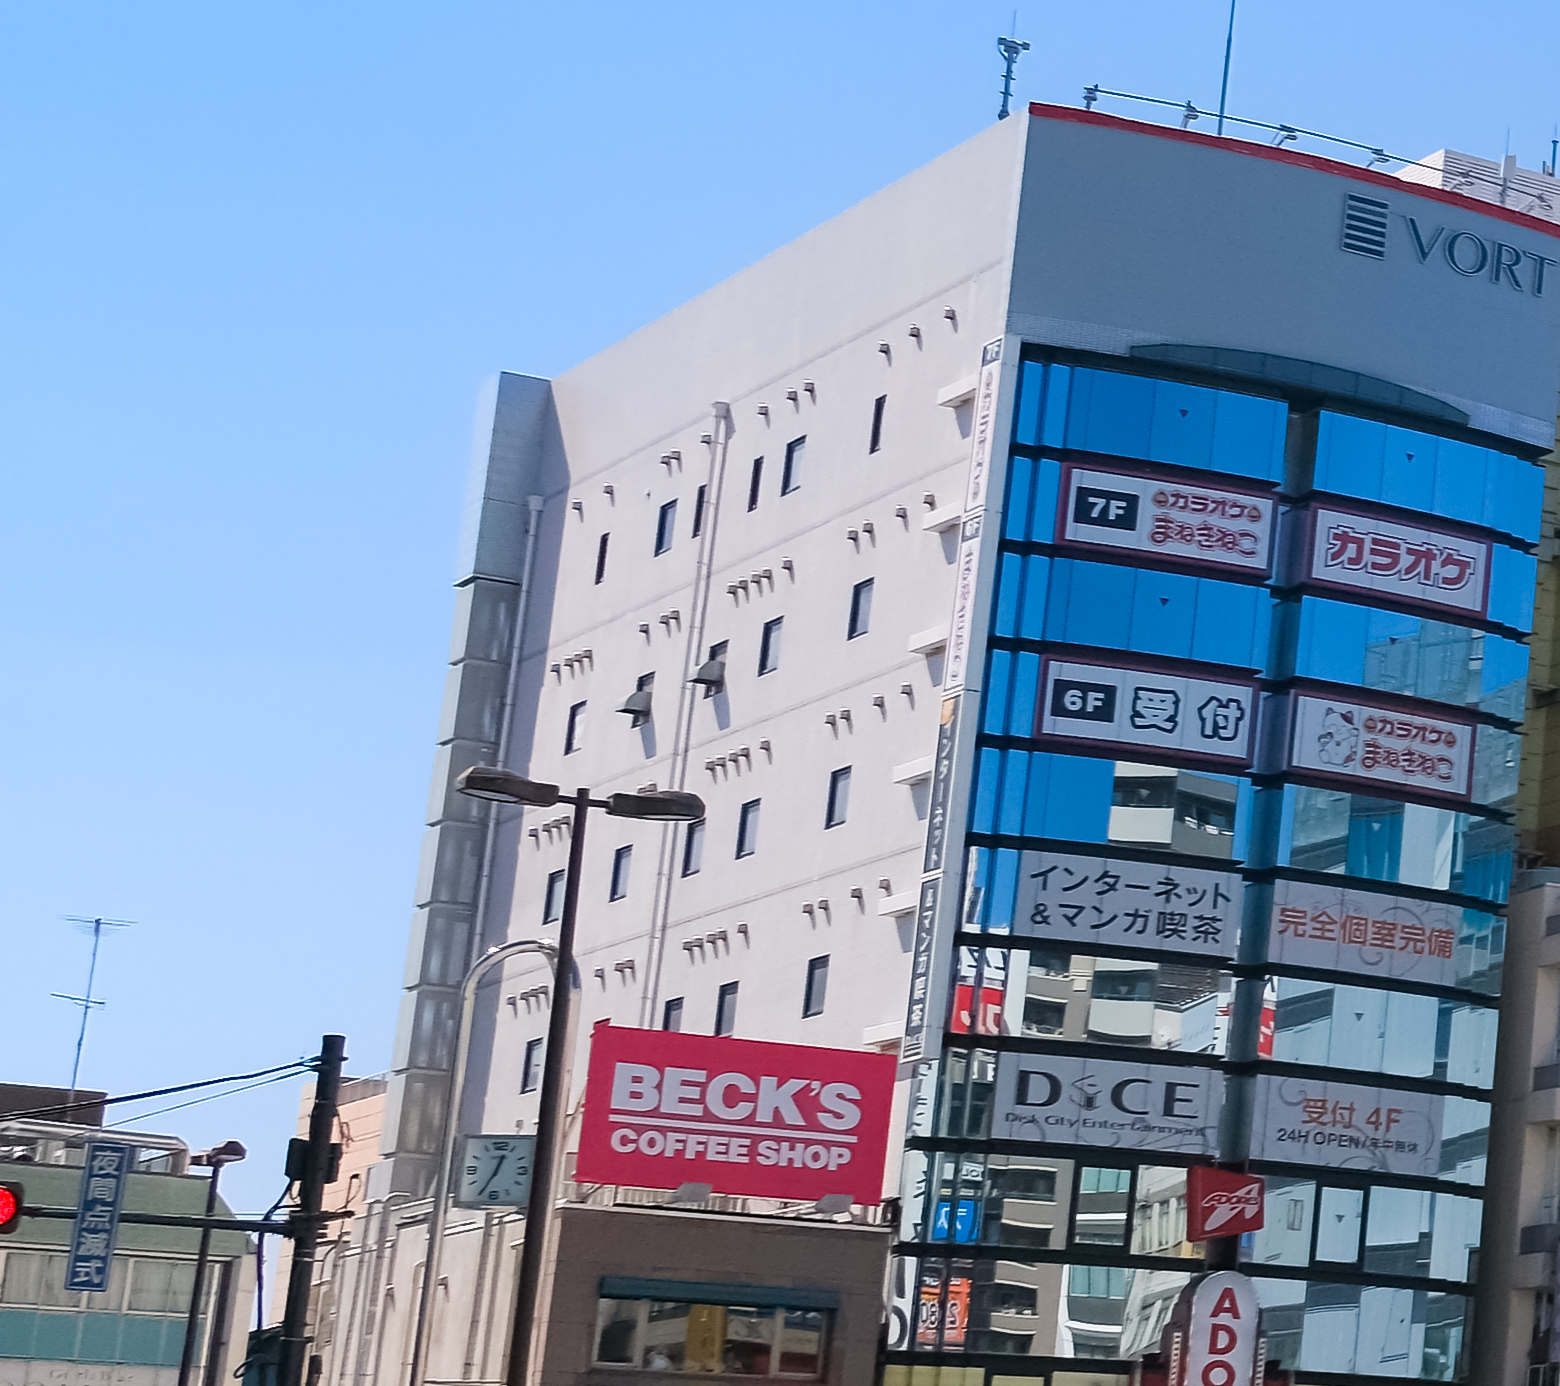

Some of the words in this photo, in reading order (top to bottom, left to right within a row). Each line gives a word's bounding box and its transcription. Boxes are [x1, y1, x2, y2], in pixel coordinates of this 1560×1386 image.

[1401, 215, 1558, 297] VORT
[1087, 496, 1127, 520] 7F
[1168, 491, 1248, 518] カラオケ
[1148, 513, 1259, 558] まねきねこ
[1325, 522, 1476, 591] カラオケ
[1063, 688, 1106, 713] 6F
[1130, 685, 1245, 742] 受付
[1375, 716, 1445, 745] カラオケ
[1360, 738, 1454, 783] まねきねこ
[1029, 864, 1232, 910] インターネット
[1029, 901, 1224, 944] &マンガ喫茶
[1277, 906, 1456, 960] 完全個室完備
[610, 1061, 862, 1131] BECK'S
[1301, 1097, 1356, 1130] 受付
[1365, 1107, 1403, 1134] 4F
[1004, 1111, 1040, 1126] Disk
[1044, 1114, 1079, 1129] City
[1276, 1127, 1310, 1145] 24H
[610, 1127, 751, 1164] COFFEE
[756, 1140, 852, 1172] SHOP
[72, 1149, 124, 1285] 夜間点滅式
